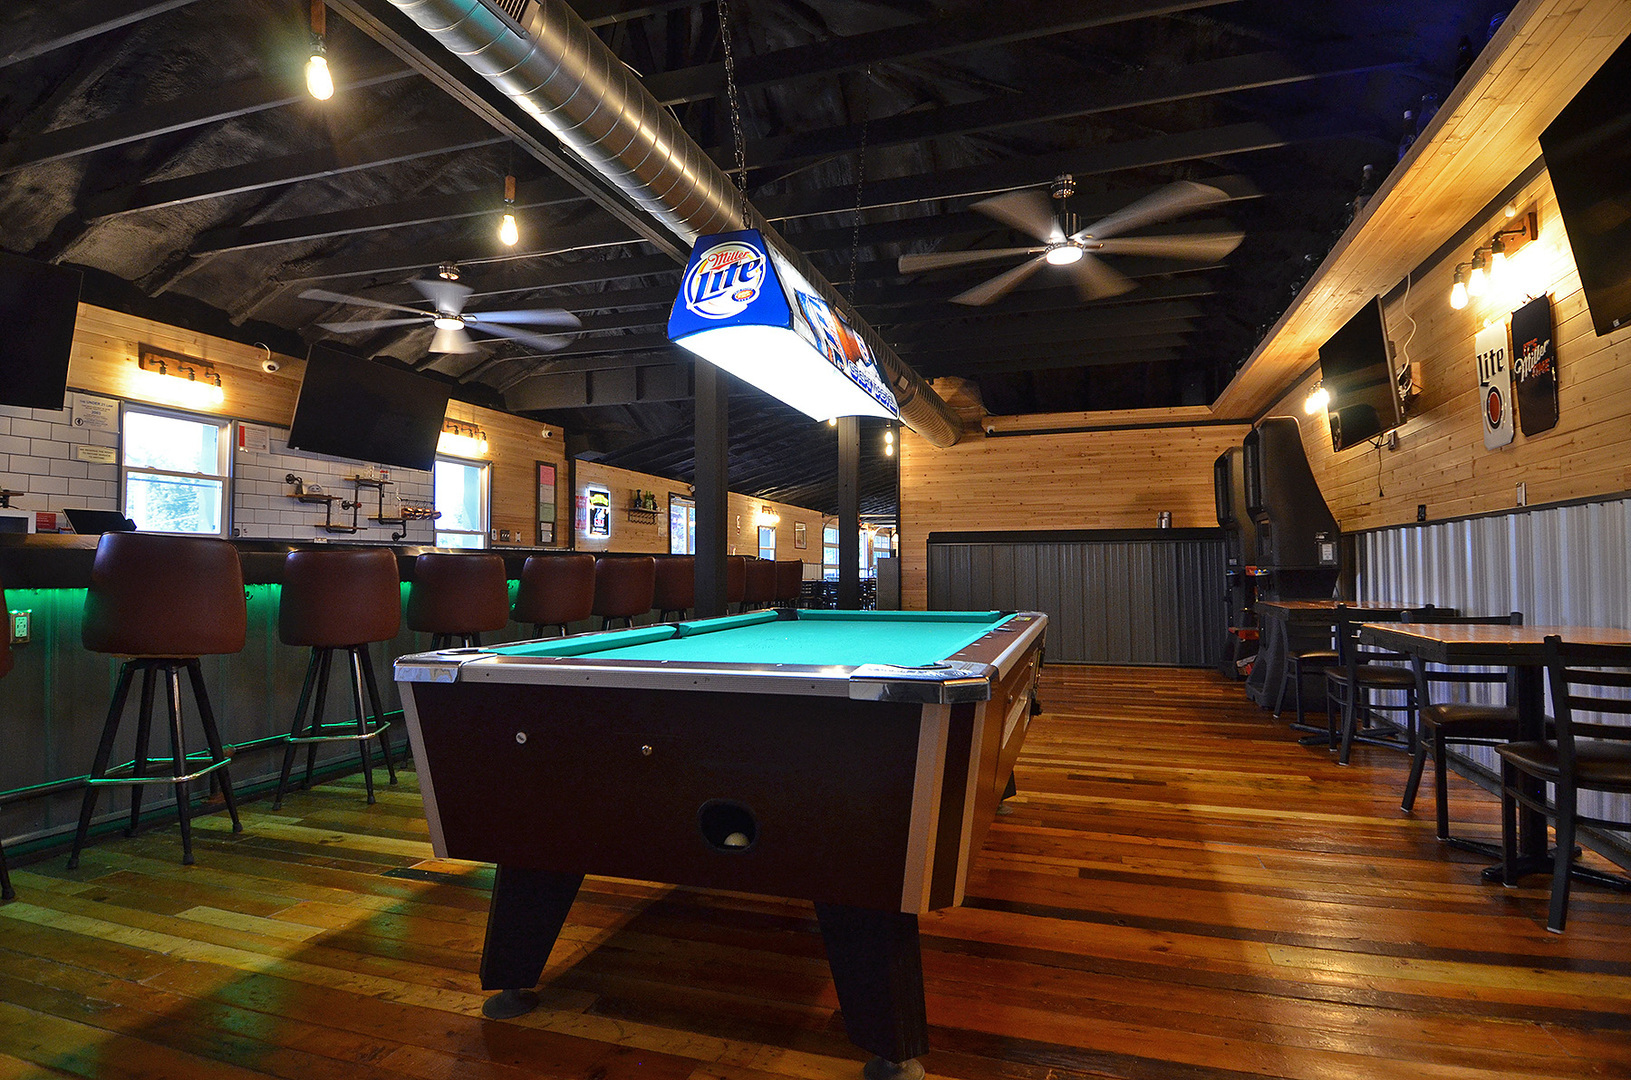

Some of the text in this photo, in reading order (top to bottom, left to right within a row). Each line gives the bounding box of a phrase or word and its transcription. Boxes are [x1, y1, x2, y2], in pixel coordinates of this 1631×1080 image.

[708, 250, 750, 268] Miller
[693, 257, 761, 304] Lite
[1477, 347, 1505, 387] Lite
[1514, 339, 1550, 382] Miller
